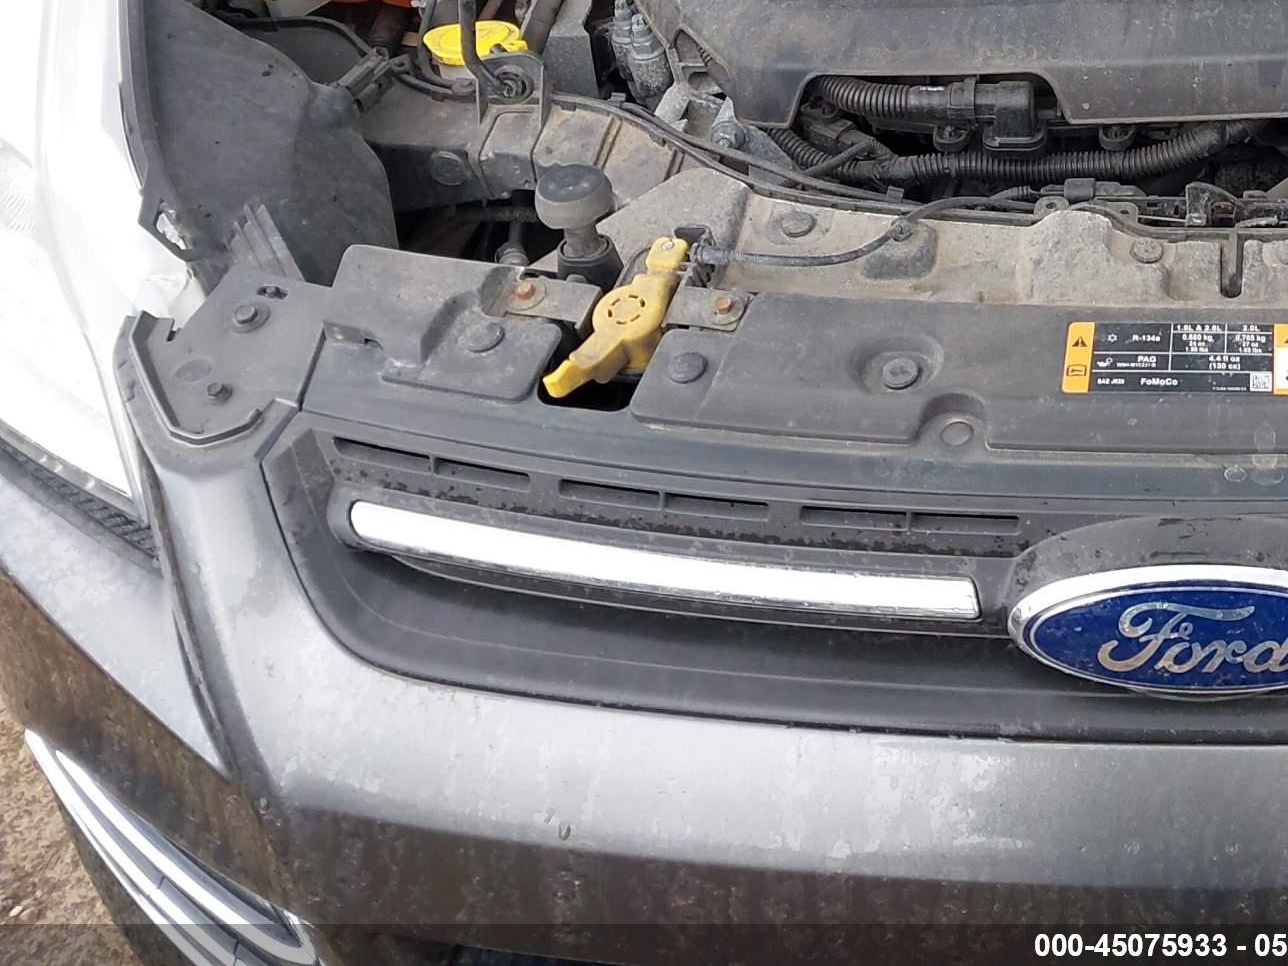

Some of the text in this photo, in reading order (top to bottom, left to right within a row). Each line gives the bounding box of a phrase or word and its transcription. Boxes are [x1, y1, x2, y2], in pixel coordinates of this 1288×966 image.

[1132, 334, 1161, 342] R-134a
[1137, 355, 1157, 363] PAG
[1140, 377, 1178, 386] FoMoCo
